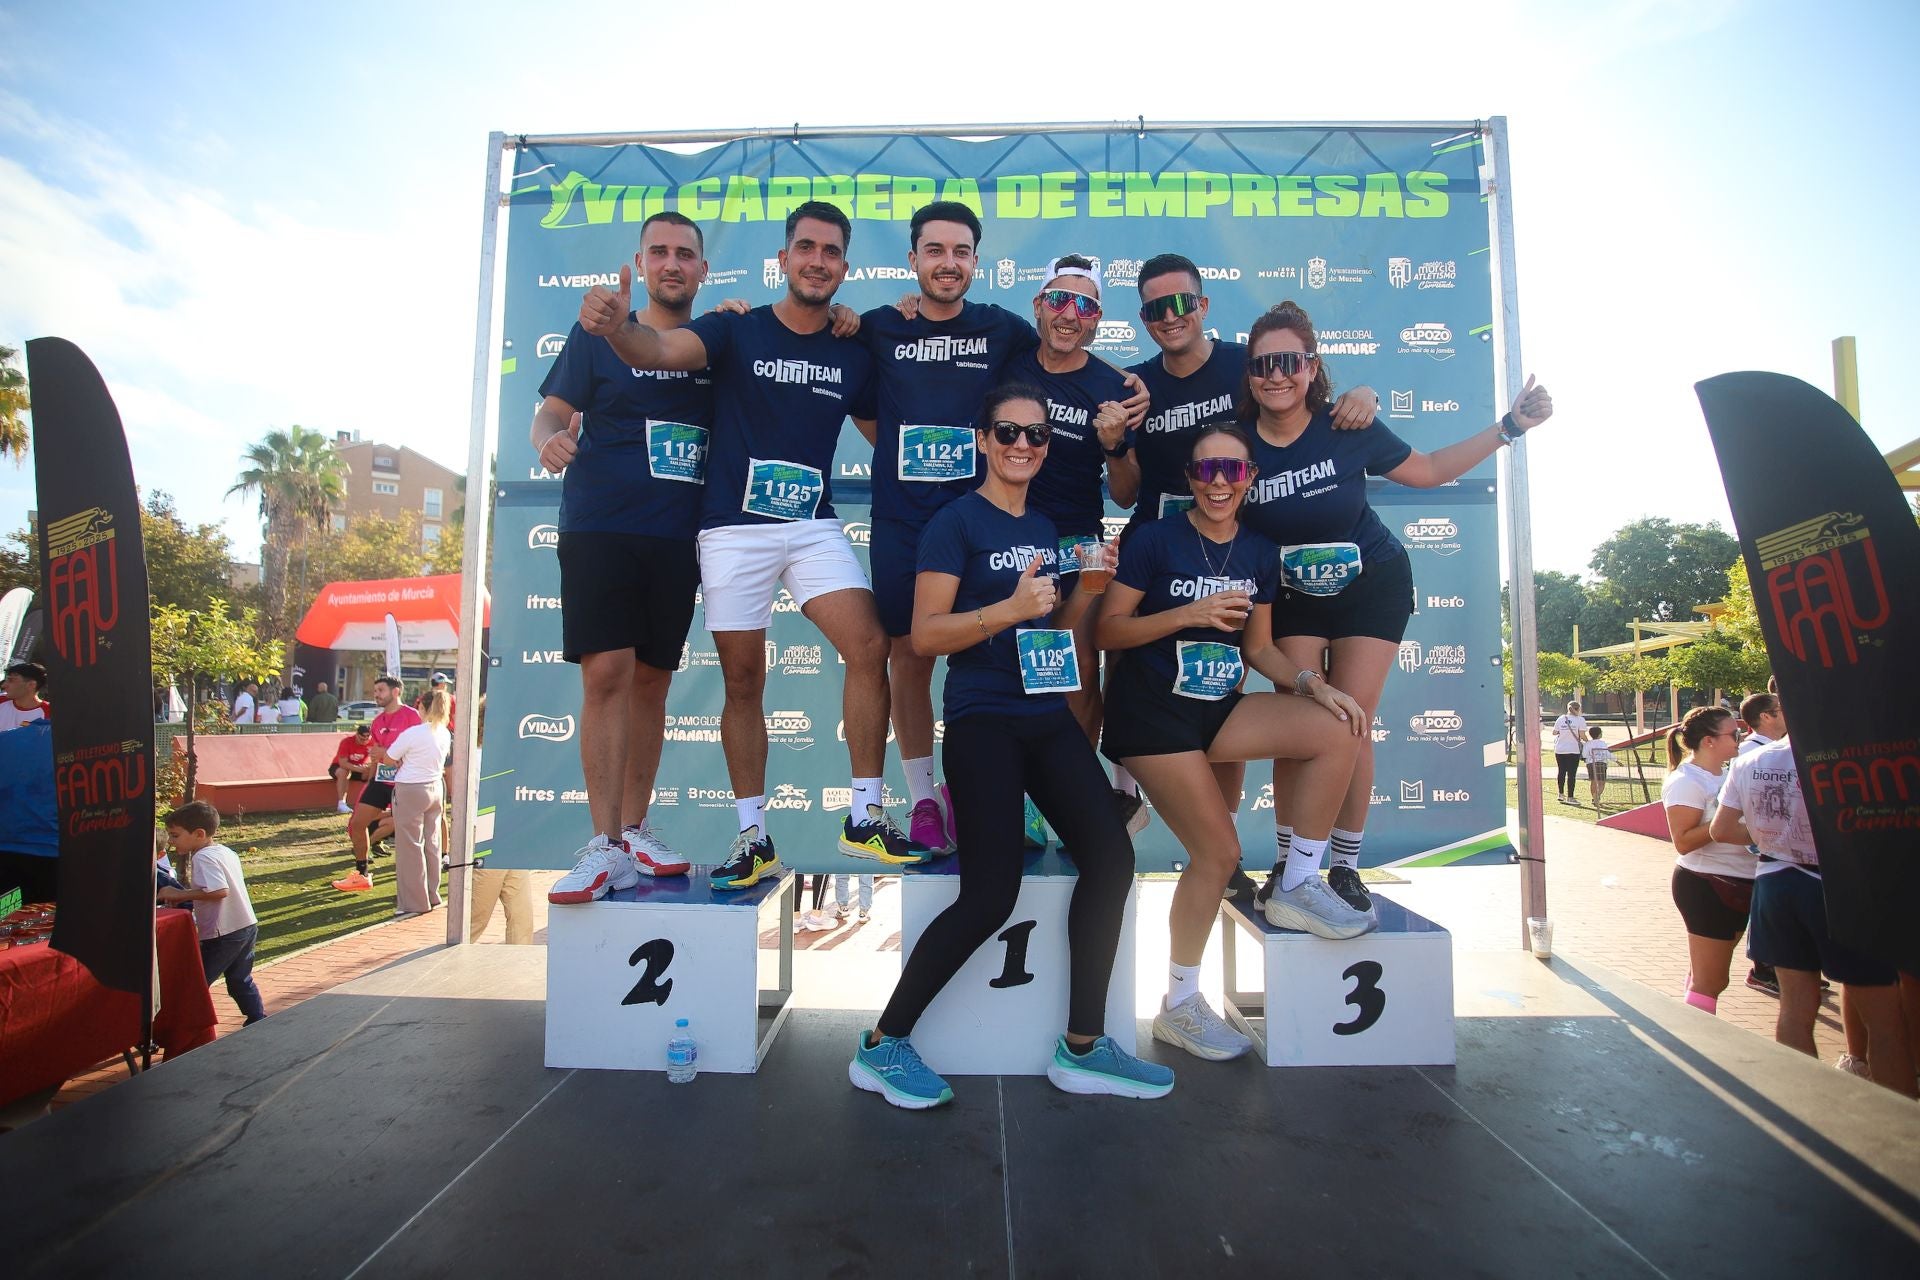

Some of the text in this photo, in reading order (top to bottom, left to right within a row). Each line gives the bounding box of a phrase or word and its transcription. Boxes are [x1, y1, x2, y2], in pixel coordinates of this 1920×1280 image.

[678, 173, 984, 223] CARRERA
[996, 171, 1077, 219] DE
[1088, 170, 1450, 219] EMPRESAS
[844, 267, 918, 280] LA VERDA
[1027, 274, 1046, 282] Murc
[1103, 270, 1140, 278] ATLETISM
[1197, 267, 1241, 280] RDAD
[1328, 267, 1373, 276] Ayuntamiento
[1413, 272, 1456, 280] ATLETISMO
[538, 272, 620, 288] LA VERDAD
[1338, 275, 1363, 283] Murcia
[1096, 327, 1134, 339] LPOZO
[545, 340, 565, 352] VID
[1421, 399, 1460, 412] Hero
[1052, 427, 1084, 441] ablenova
[914, 443, 964, 460] 1124
[764, 479, 811, 502] 1125
[536, 531, 560, 544] VID
[849, 530, 871, 542] VID
[1294, 563, 1348, 580] 1123
[328, 585, 435, 607] Ayuntamiento de Murcia
[1427, 596, 1465, 609] Hero
[522, 651, 542, 663] LA
[702, 658, 721, 666] Murc
[779, 657, 822, 665] ATLETISMO
[1027, 649, 1065, 668] 1128
[1424, 657, 1466, 665] ATLETISMO
[1194, 659, 1235, 679] 1122
[526, 721, 567, 734] VIDAL
[700, 716, 722, 726] GLOB
[1841, 739, 1917, 758] ATLETISMO
[57, 753, 146, 809] FAMU
[1752, 769, 1793, 783] bionet
[1810, 755, 1920, 806] FAM
[515, 785, 555, 802] itres
[560, 789, 589, 800] atal
[1432, 788, 1470, 802] Hero
[989, 920, 1036, 989] 1
[621, 938, 675, 1006] 2
[1333, 960, 1386, 1036] 3
